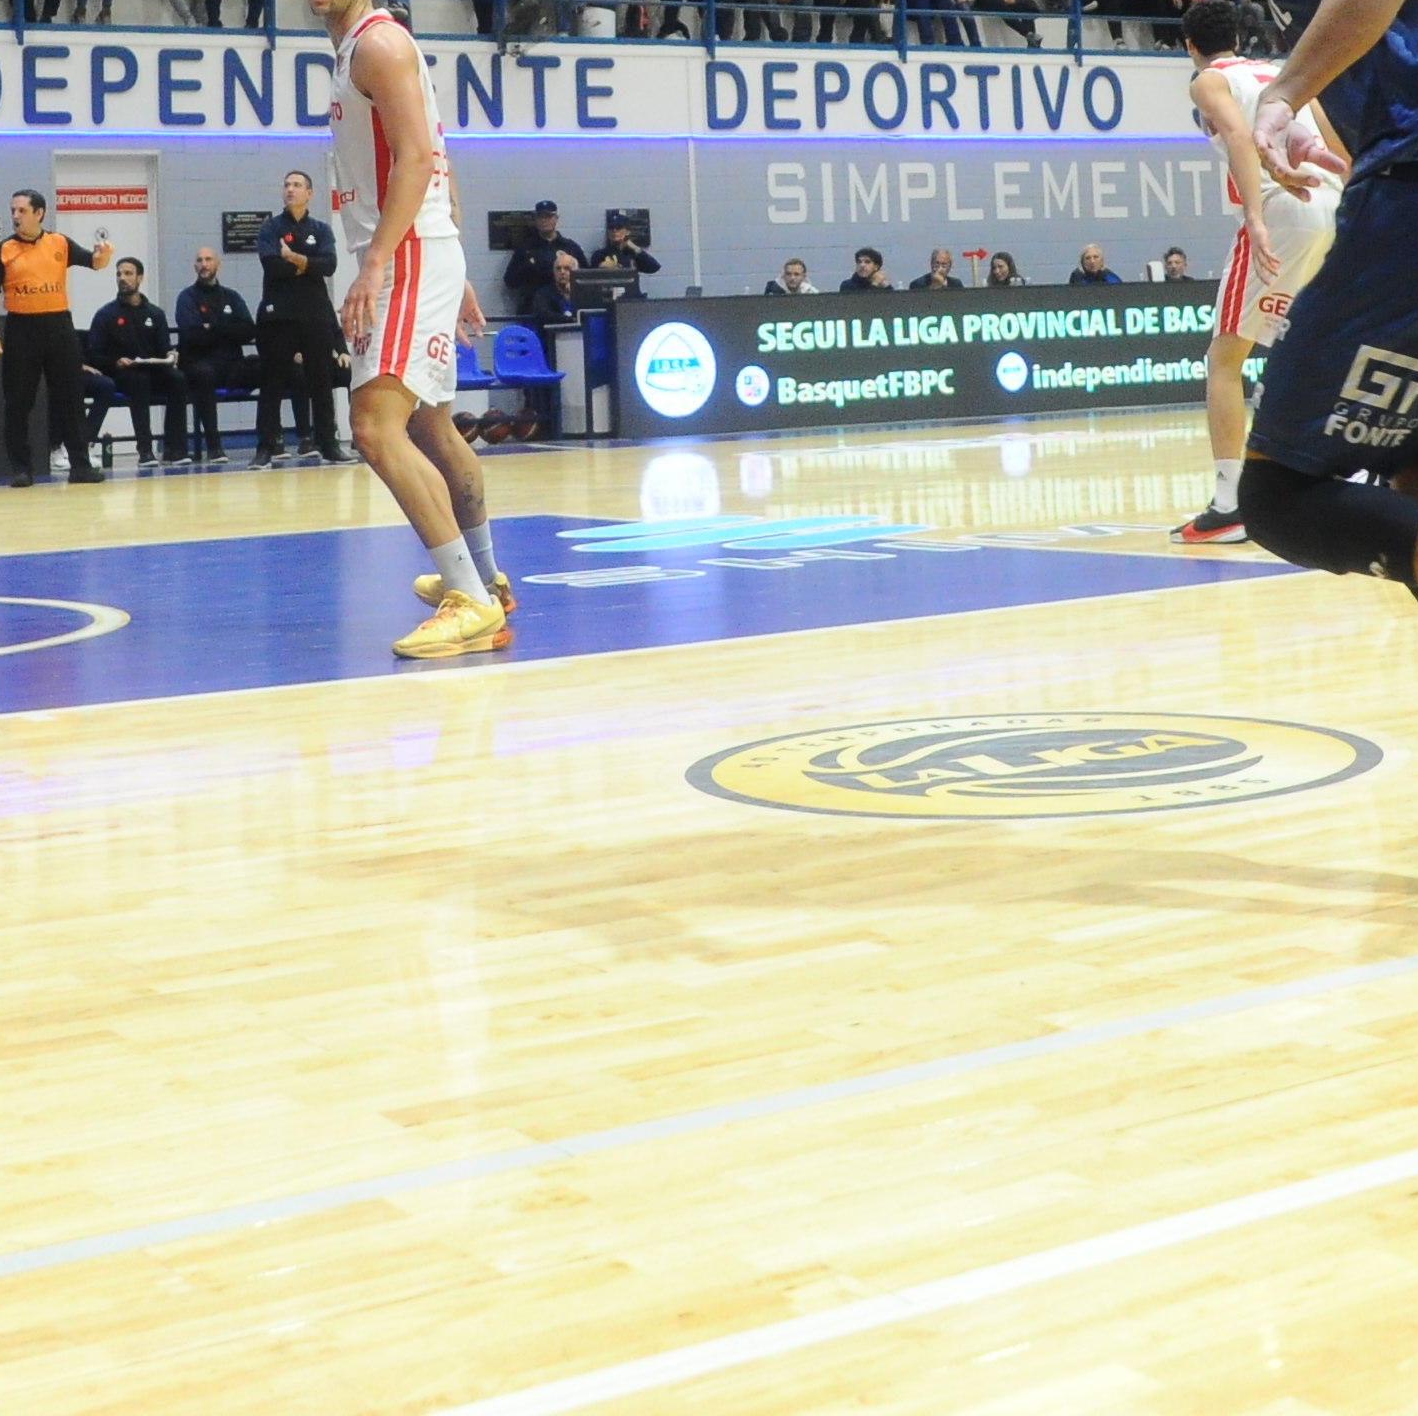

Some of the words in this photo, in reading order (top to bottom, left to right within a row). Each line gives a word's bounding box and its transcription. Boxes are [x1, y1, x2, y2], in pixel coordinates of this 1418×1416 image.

[706, 61, 1125, 131] DEPORTIVO
[757, 322, 847, 353] SEGUI
[852, 318, 884, 347] LA
[893, 314, 960, 346] LIGA
[962, 307, 1123, 342] PROVINCIAL
[1125, 306, 1161, 336] DE
[777, 368, 956, 409] BasquetFBPC
[1323, 413, 1413, 448] FONTE
